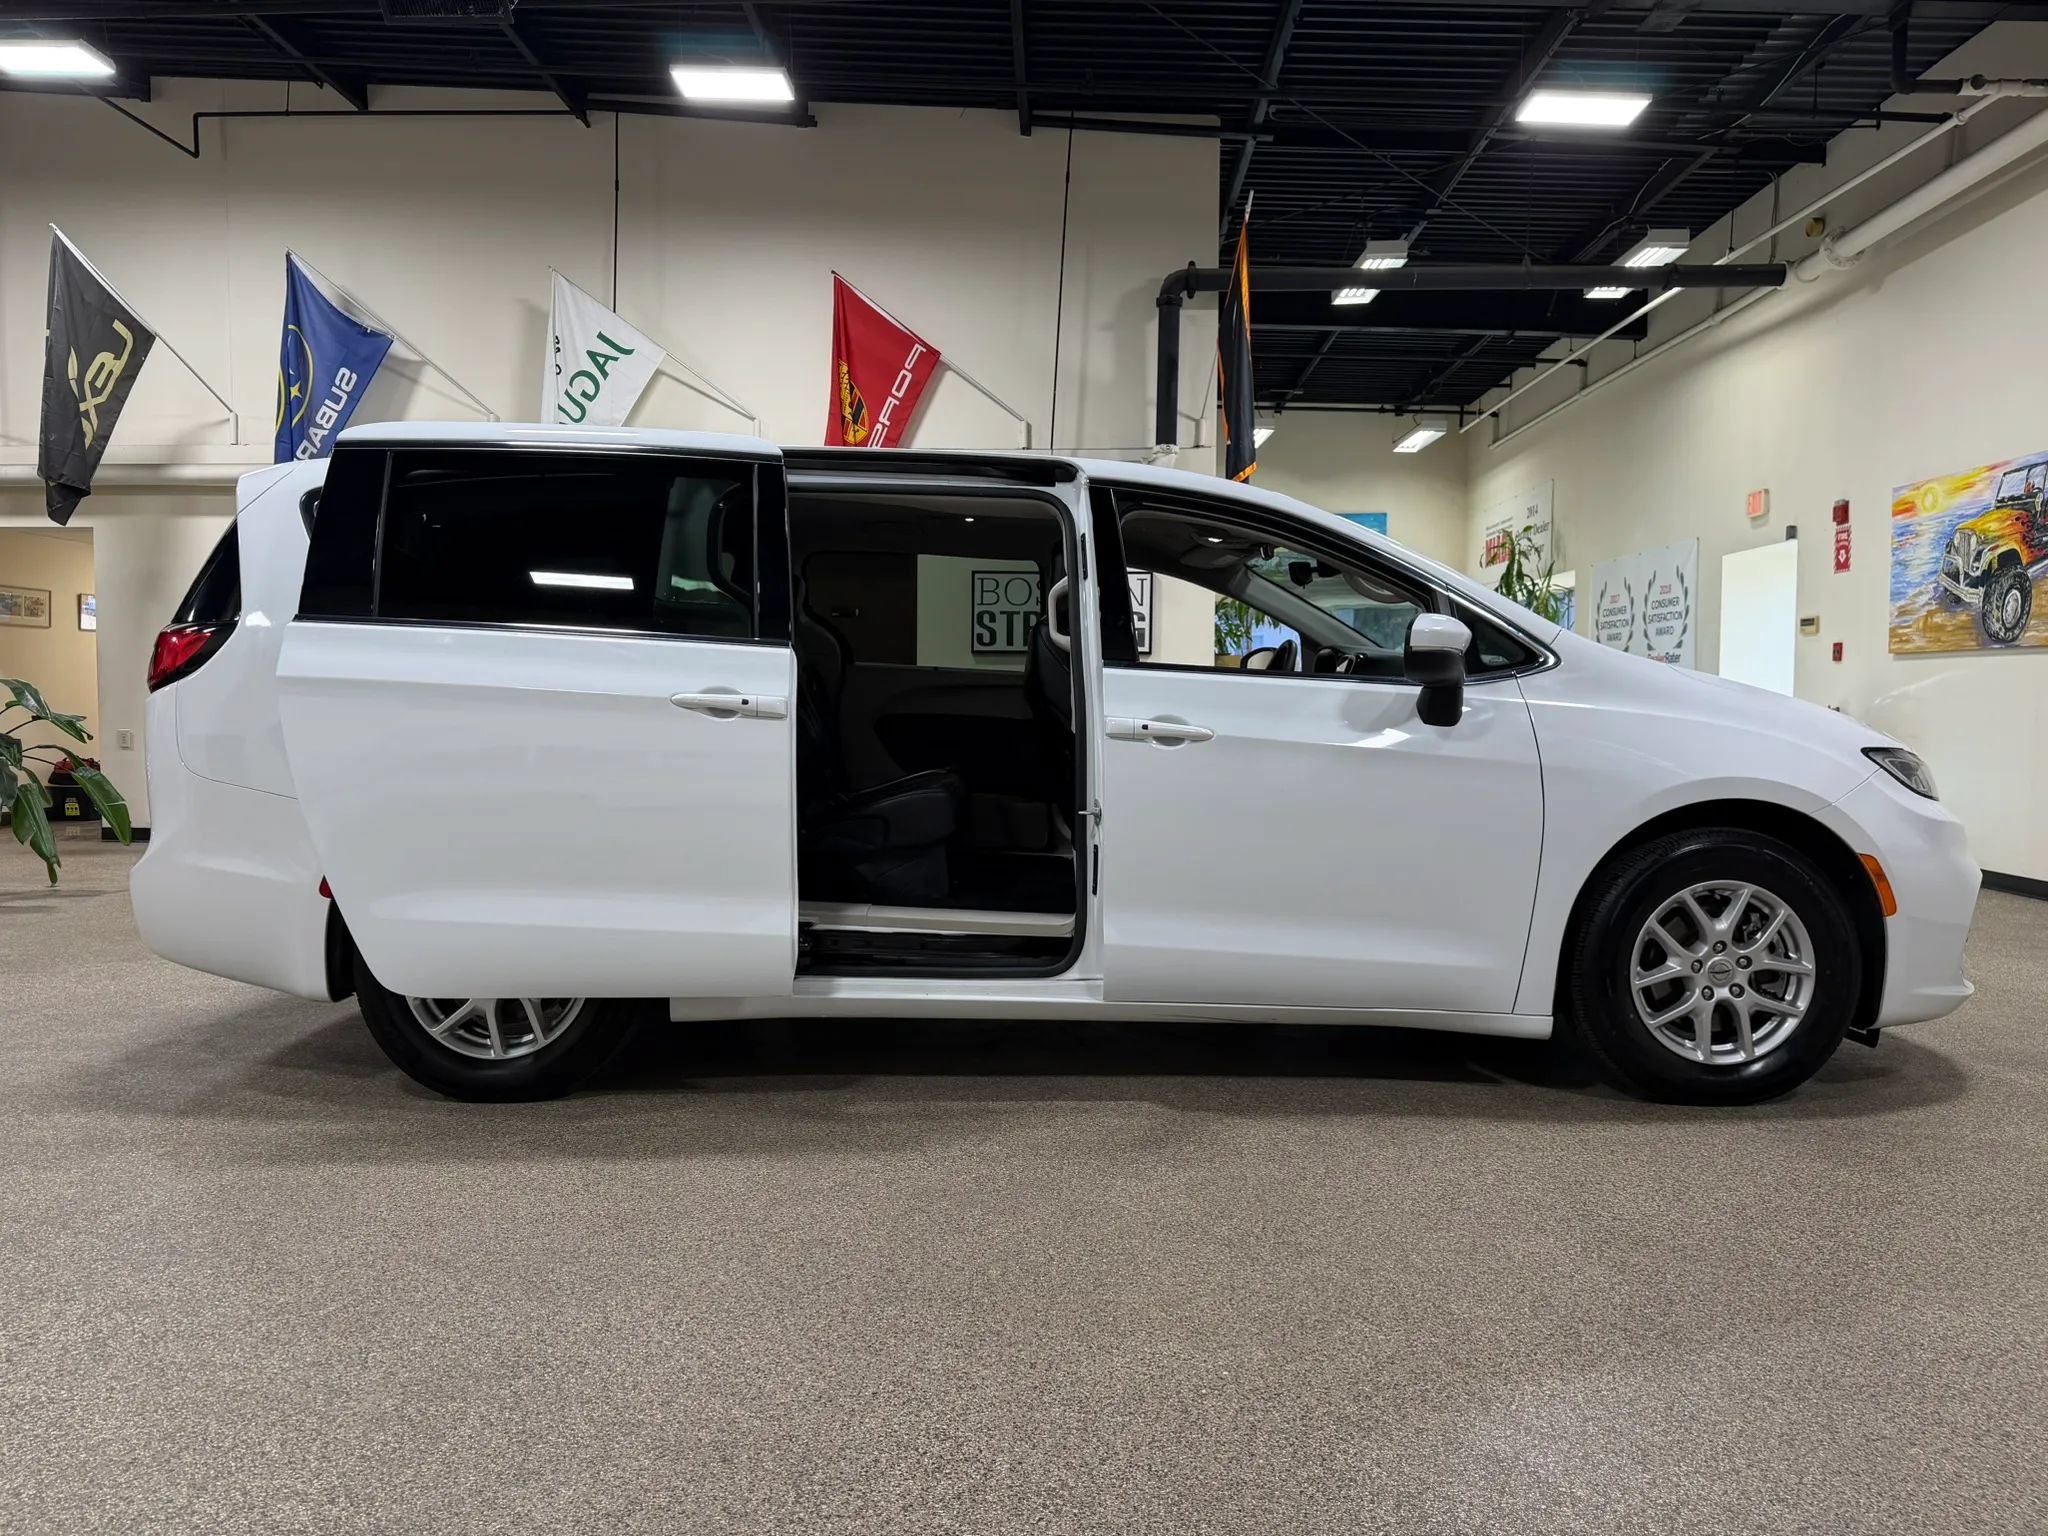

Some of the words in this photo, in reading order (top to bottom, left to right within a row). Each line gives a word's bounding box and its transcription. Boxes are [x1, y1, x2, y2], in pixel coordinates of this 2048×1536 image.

[1650, 596, 1680, 610] CONSUMER
[1602, 605, 1627, 618] CONSUMER
[1647, 611, 1683, 624] SATISFACTION
[1600, 619, 1629, 630] SATISFACTION
[1606, 632, 1622, 642] AWARD
[1655, 626, 1674, 636] AWARD
